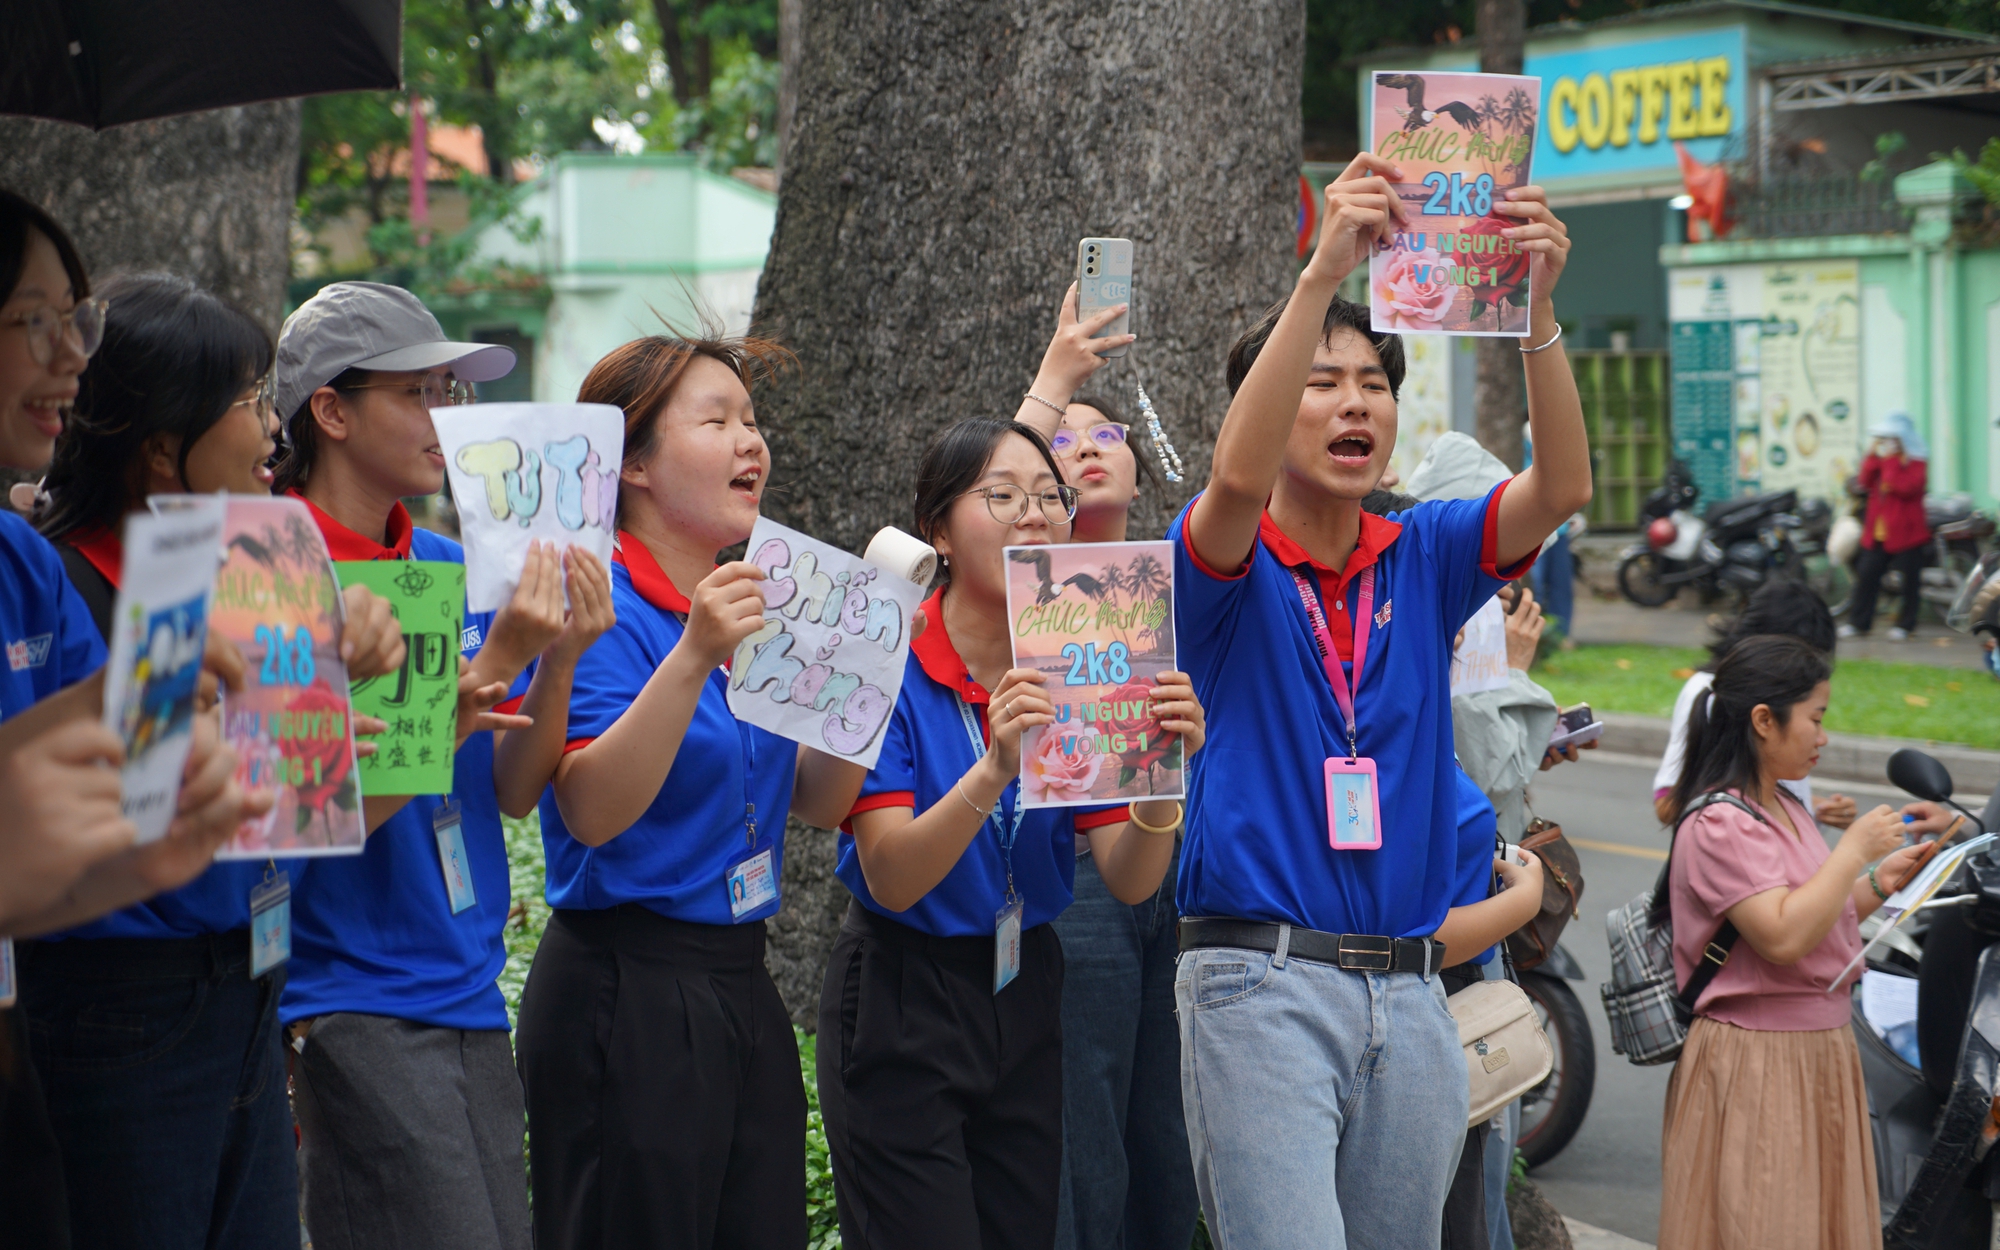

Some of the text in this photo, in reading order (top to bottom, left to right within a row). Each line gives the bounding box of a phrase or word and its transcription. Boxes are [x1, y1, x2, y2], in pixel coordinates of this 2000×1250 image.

[1548, 57, 1731, 152] COFFEE
[1377, 126, 1461, 163] CHÚC
[1422, 171, 1495, 217] 2k8
[1413, 264, 1498, 289] VỌNG 1
[456, 437, 541, 528] Tự
[1016, 599, 1091, 637] CHÚC
[254, 622, 316, 687] 2k8
[1061, 641, 1131, 687] 2k8
[1060, 732, 1148, 758] VỌNG 1
[312, 756, 323, 785] 1
